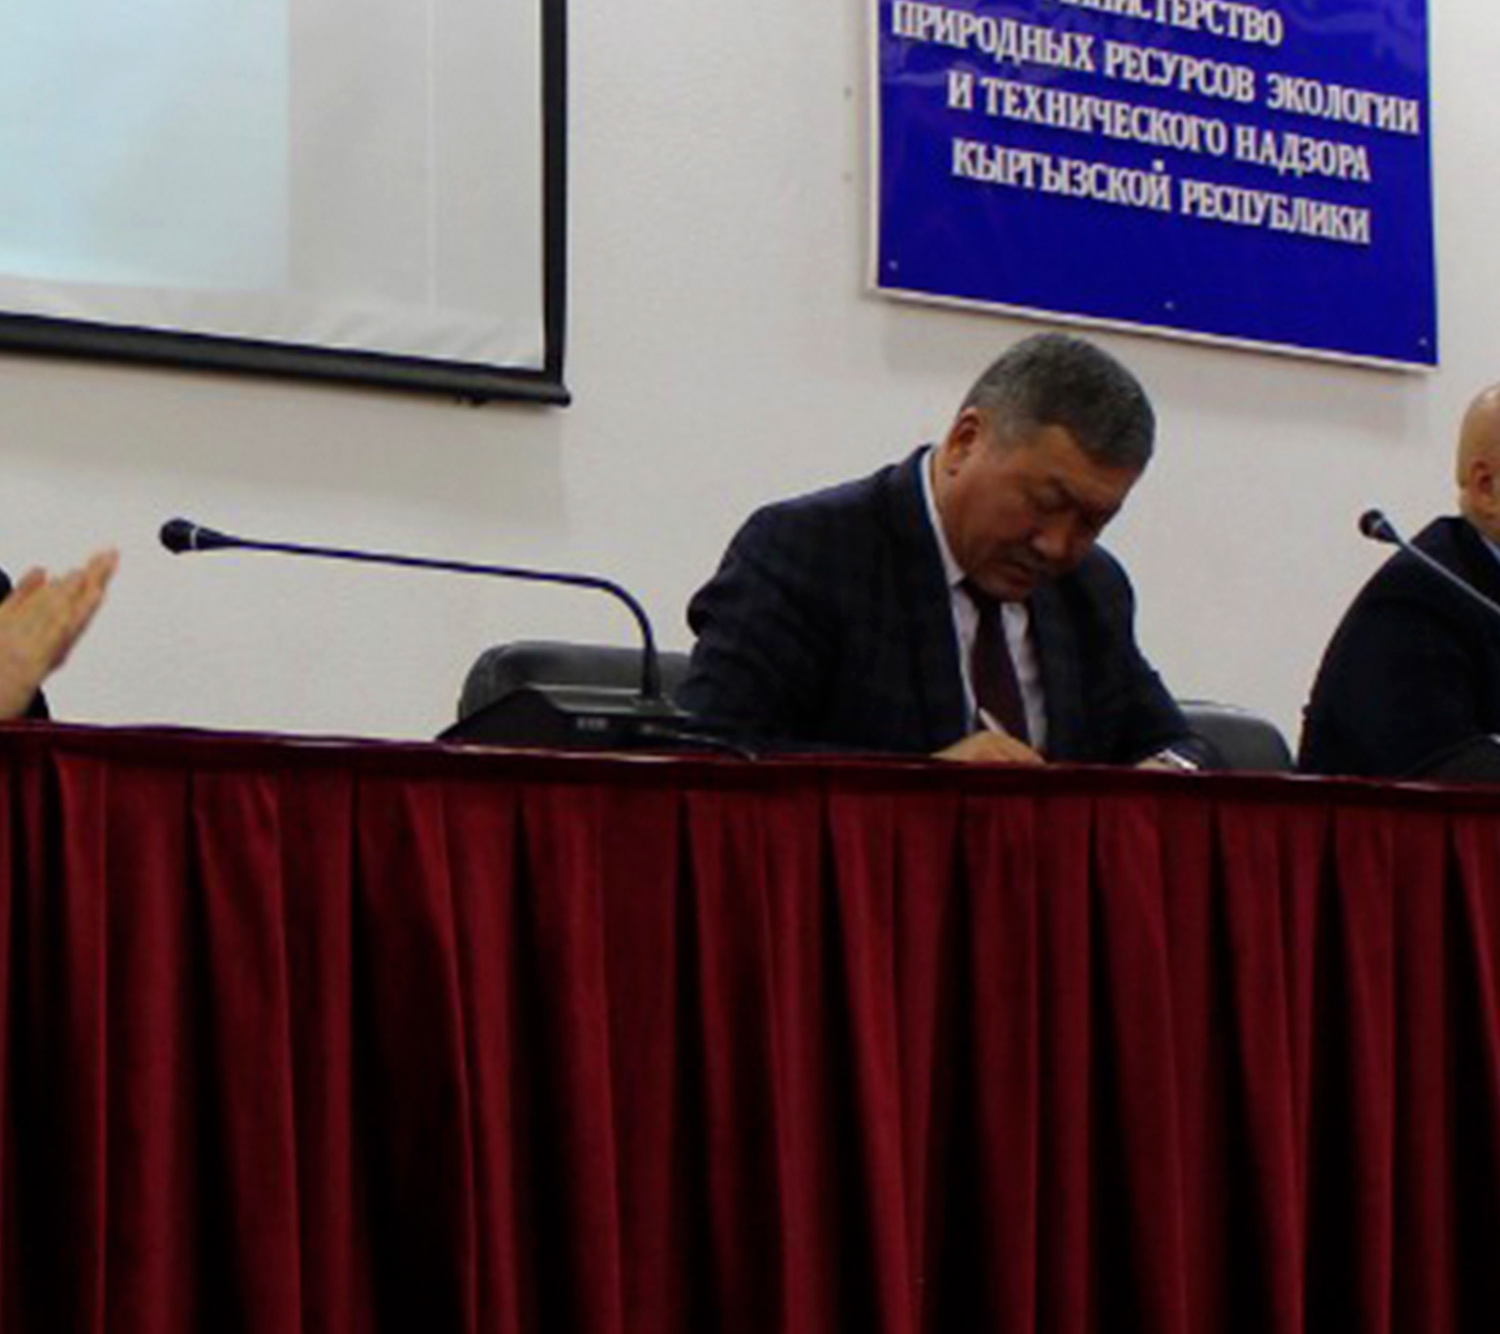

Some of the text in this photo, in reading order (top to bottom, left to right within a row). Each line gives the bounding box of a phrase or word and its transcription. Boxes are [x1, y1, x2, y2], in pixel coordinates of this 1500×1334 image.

[947, 72, 1372, 182] И ТЕХНИЧЕСКОГО НАДЗОРА
[1103, 39, 1256, 103] РЕСУРСОВ
[1265, 72, 1420, 135] ЭКОЛОГИИ
[951, 139, 1371, 245] КЫРГЫЗСКОЙ РЕСПУБЛИКИ
